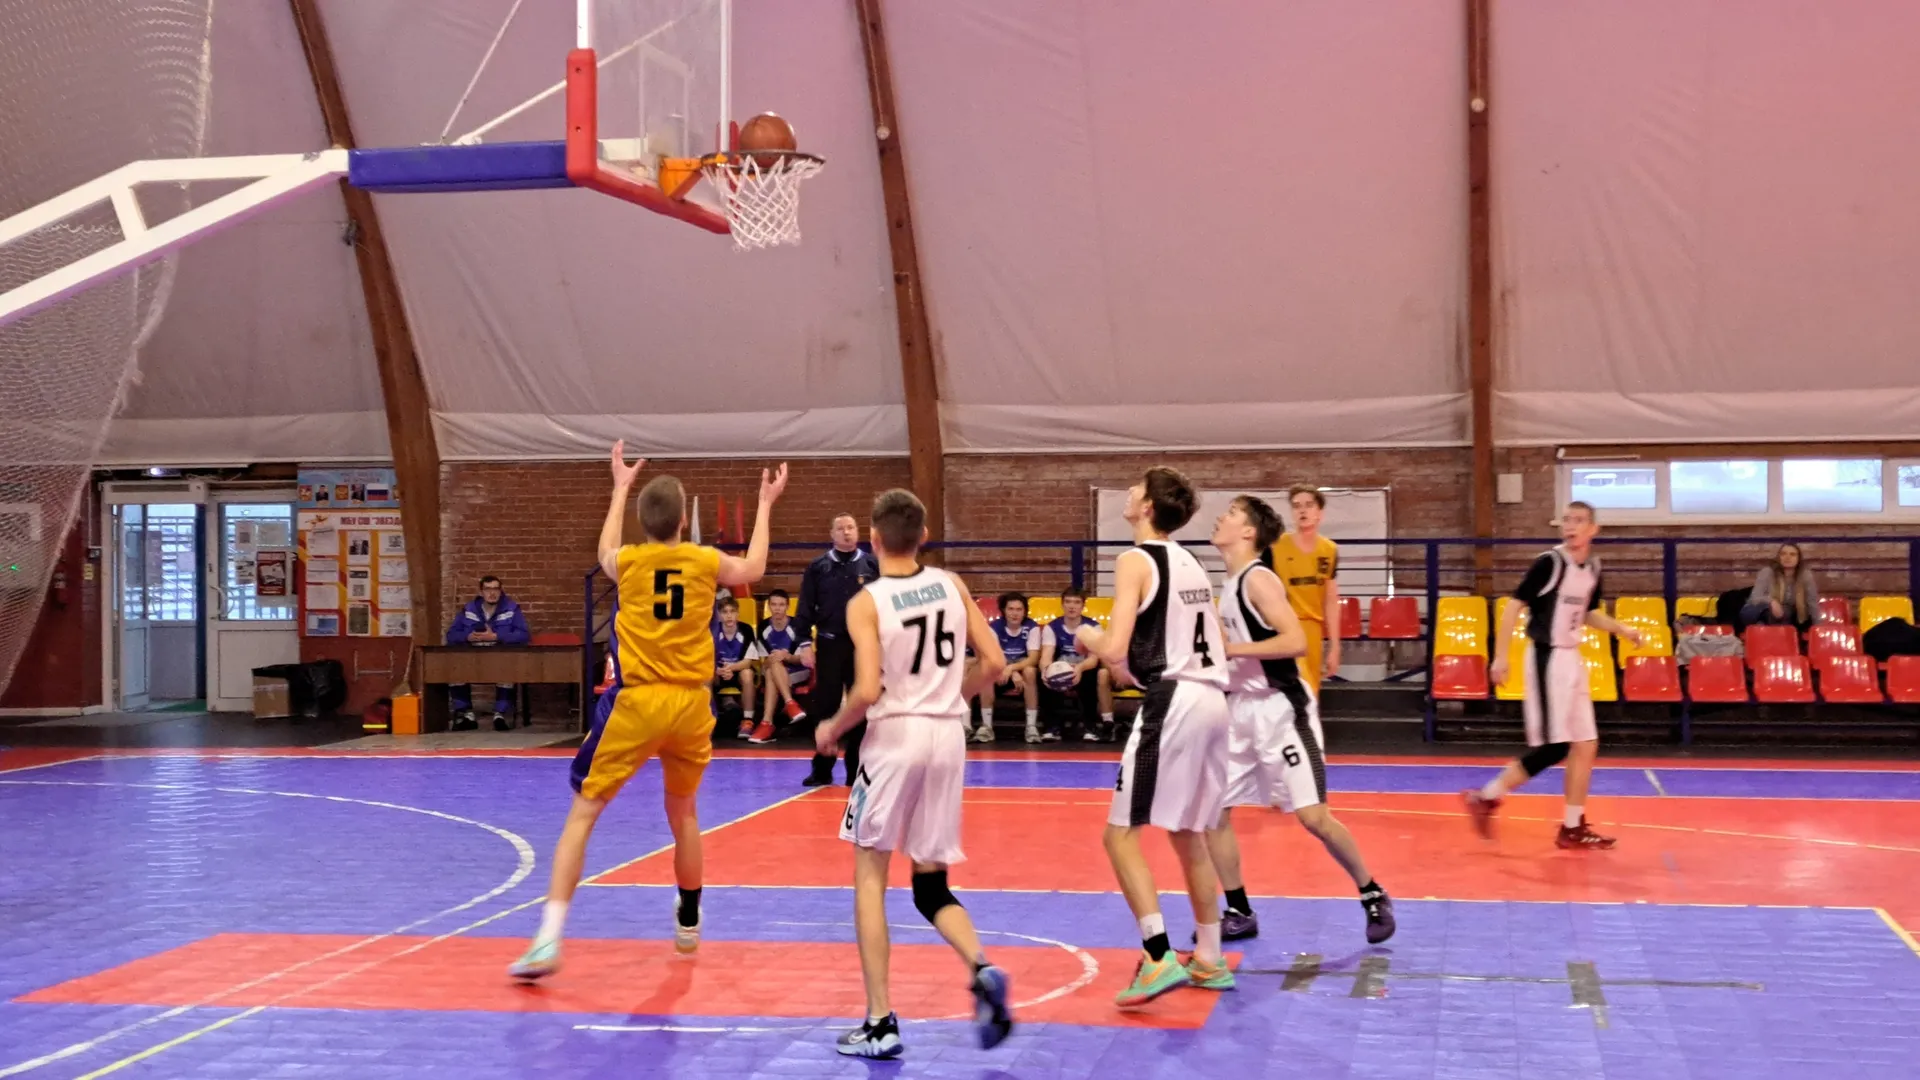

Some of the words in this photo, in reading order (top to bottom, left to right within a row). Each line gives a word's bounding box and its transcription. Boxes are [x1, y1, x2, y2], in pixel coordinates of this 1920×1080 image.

[653, 569, 684, 620] 5
[902, 609, 955, 675] 76
[1193, 611, 1215, 669] 4
[1281, 744, 1300, 767] 6
